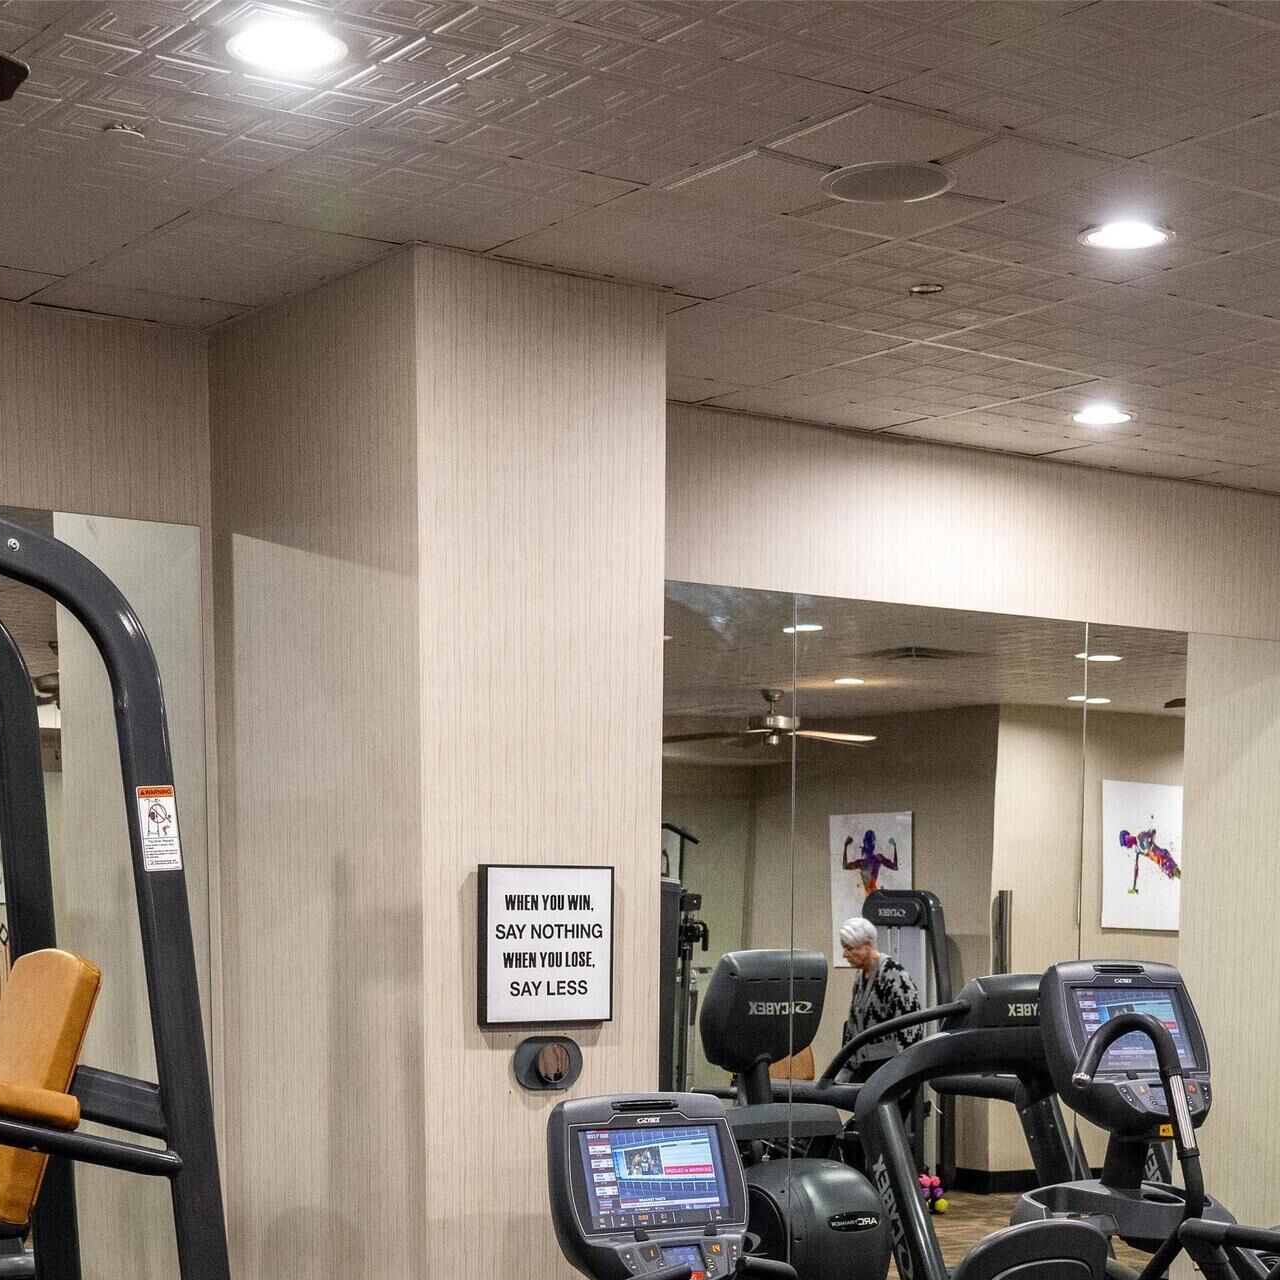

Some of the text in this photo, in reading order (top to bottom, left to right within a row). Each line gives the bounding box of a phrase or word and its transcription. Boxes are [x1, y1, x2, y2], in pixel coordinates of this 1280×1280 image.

[505, 894, 594, 912] WHEN YOU WIN,
[495, 923, 603, 940] SAY NOTHING
[503, 951, 596, 969] WHEN YOU LOSE,
[509, 979, 588, 997] SAY LESS
